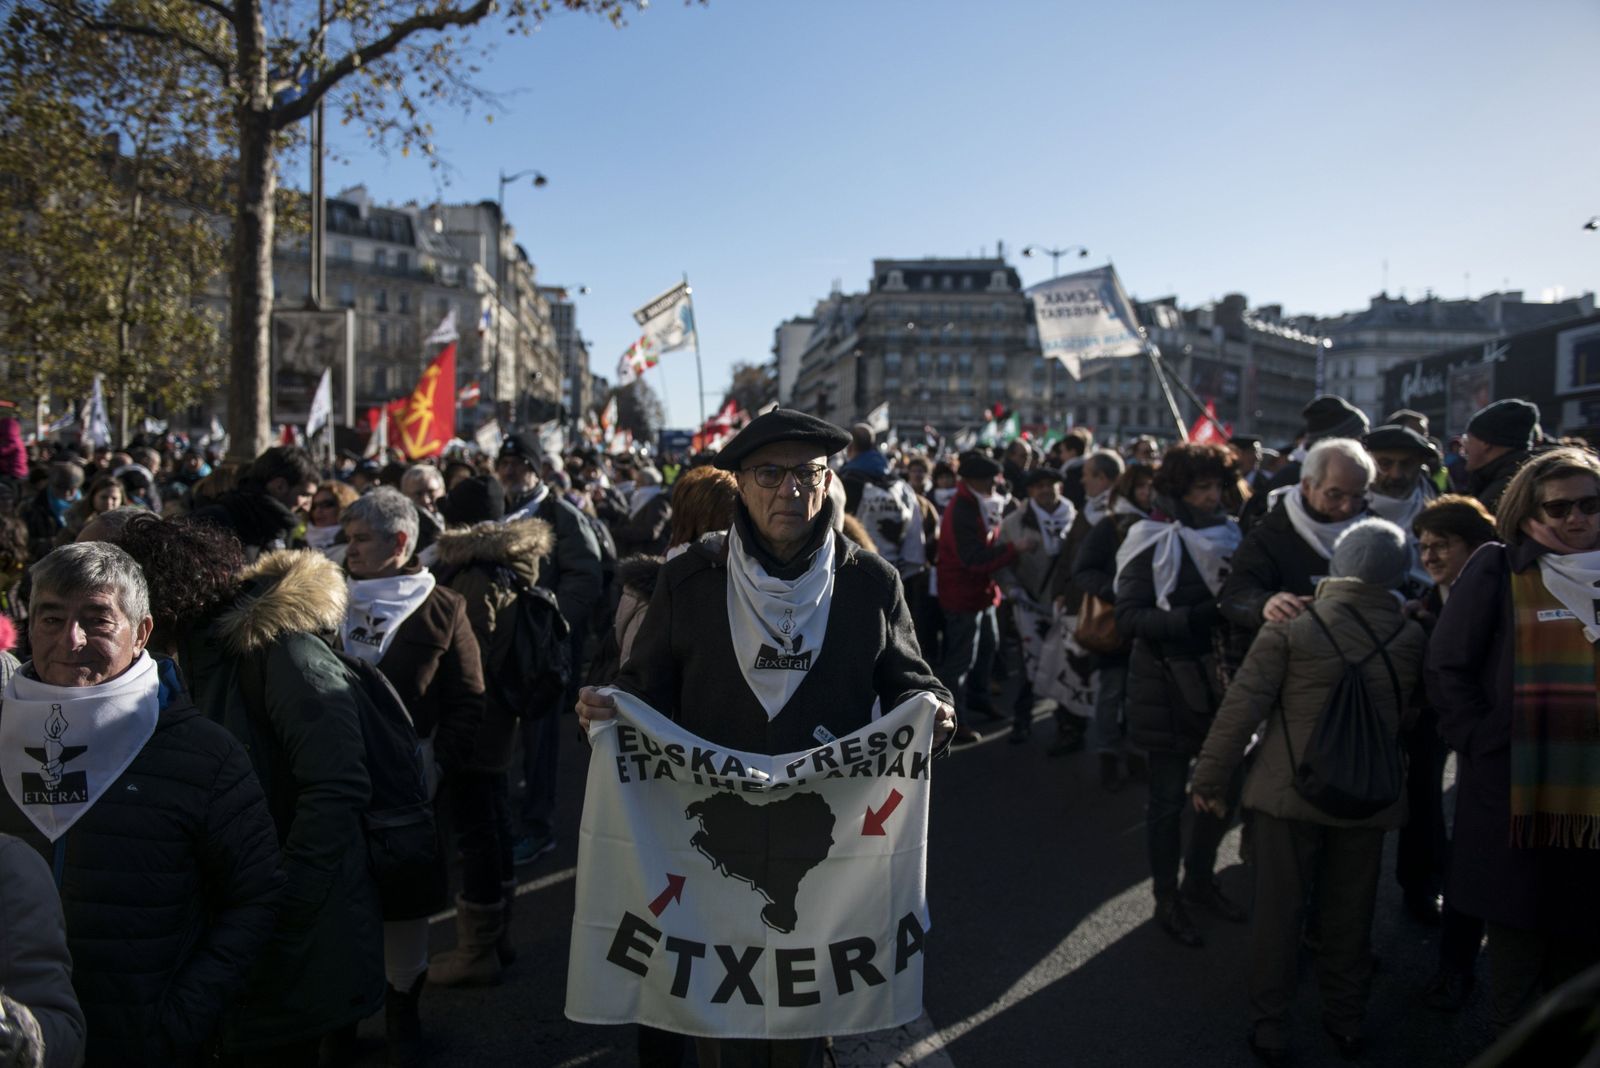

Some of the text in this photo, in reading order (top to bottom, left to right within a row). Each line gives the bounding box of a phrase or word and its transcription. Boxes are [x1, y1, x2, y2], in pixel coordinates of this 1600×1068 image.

[616, 754, 678, 783] ETA
[785, 725, 915, 778] PRESO
[24, 790, 86, 803] ETXERA!
[606, 911, 925, 1007] ETXERA
